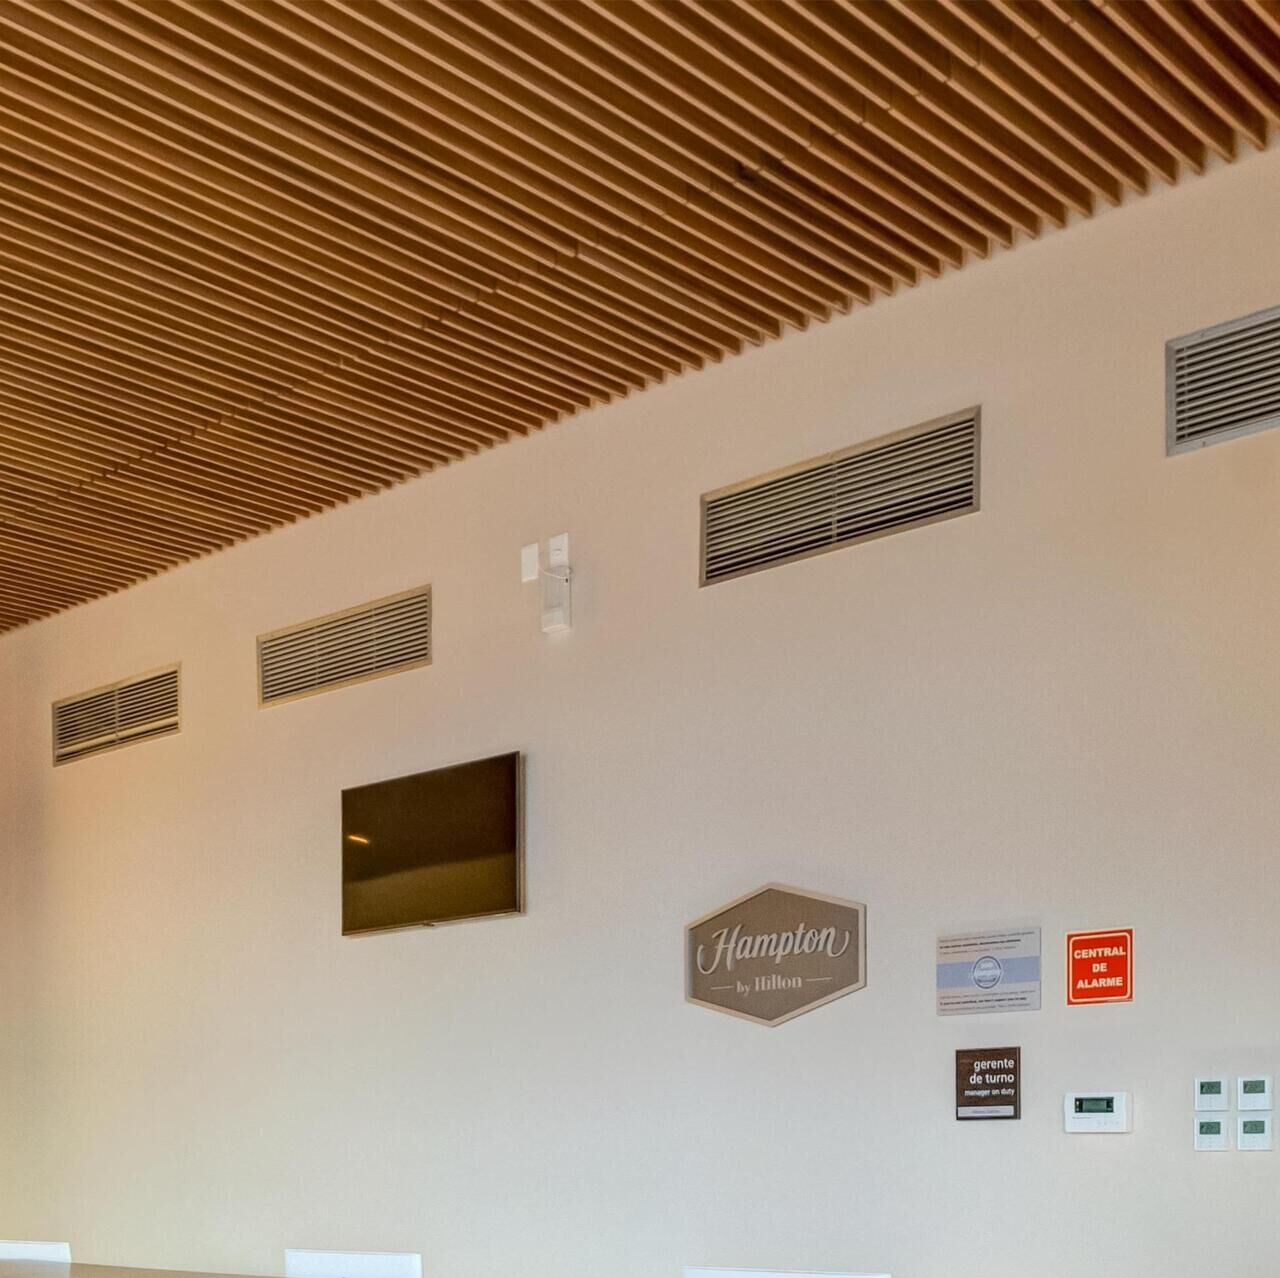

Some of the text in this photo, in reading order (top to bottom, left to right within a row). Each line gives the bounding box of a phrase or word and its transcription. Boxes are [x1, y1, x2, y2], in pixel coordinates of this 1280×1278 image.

[697, 923, 849, 974] Hampton
[1074, 946, 1126, 959] CENTRAL
[1092, 963, 1107, 973] DE
[736, 975, 802, 996] by Hilton
[1076, 977, 1123, 989] ALARME
[974, 1059, 1014, 1072] gerente
[969, 1073, 1015, 1084] de turno
[964, 1089, 990, 1098] manager
[1001, 1088, 1015, 1096] duty
